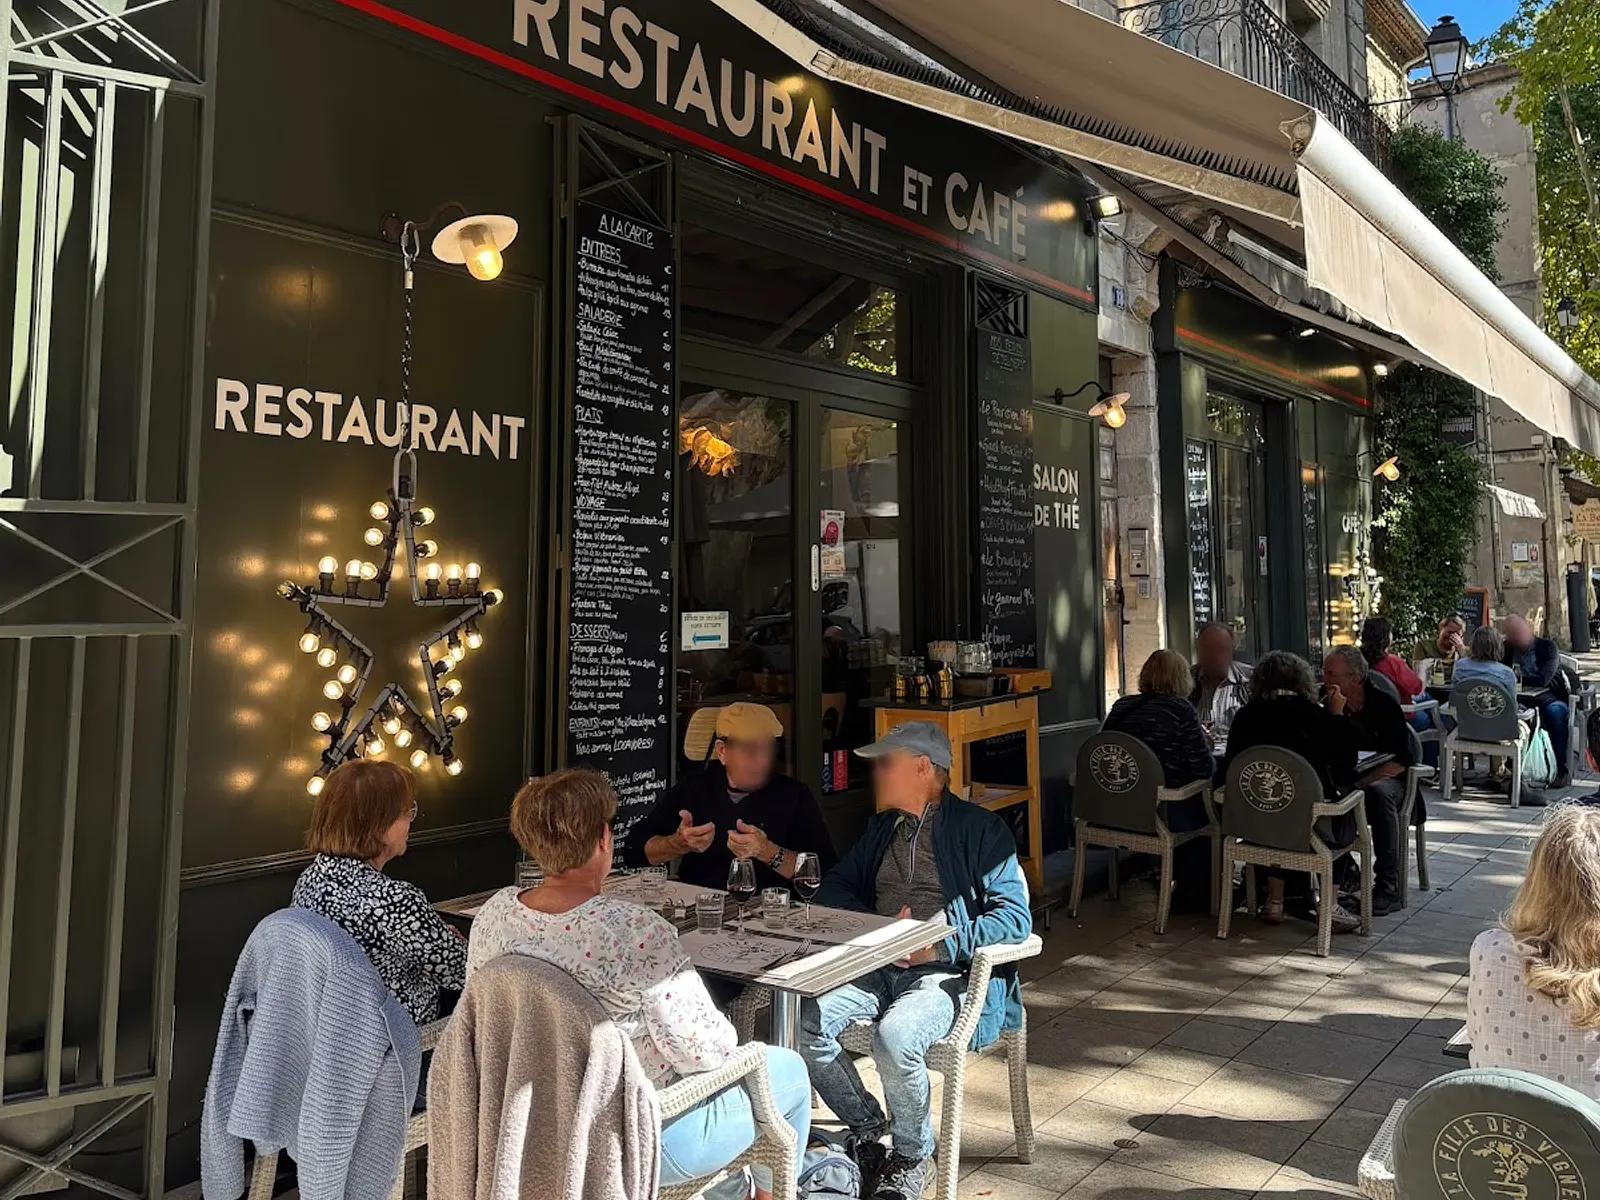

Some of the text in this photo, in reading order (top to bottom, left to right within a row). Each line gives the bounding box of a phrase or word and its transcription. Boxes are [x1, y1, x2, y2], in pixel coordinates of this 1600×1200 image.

[512, 0, 1028, 257] RESTAURANT ET CAFÉ
[214, 377, 525, 460] RESTAURANT
[1033, 462, 1079, 497] SALON
[1034, 504, 1050, 528] DE
[1053, 496, 1080, 530] THÉ
[1437, 1118, 1480, 1163] FILLE
[1484, 1115, 1528, 1140] DES
[1440, 1171, 1464, 1195] LA
